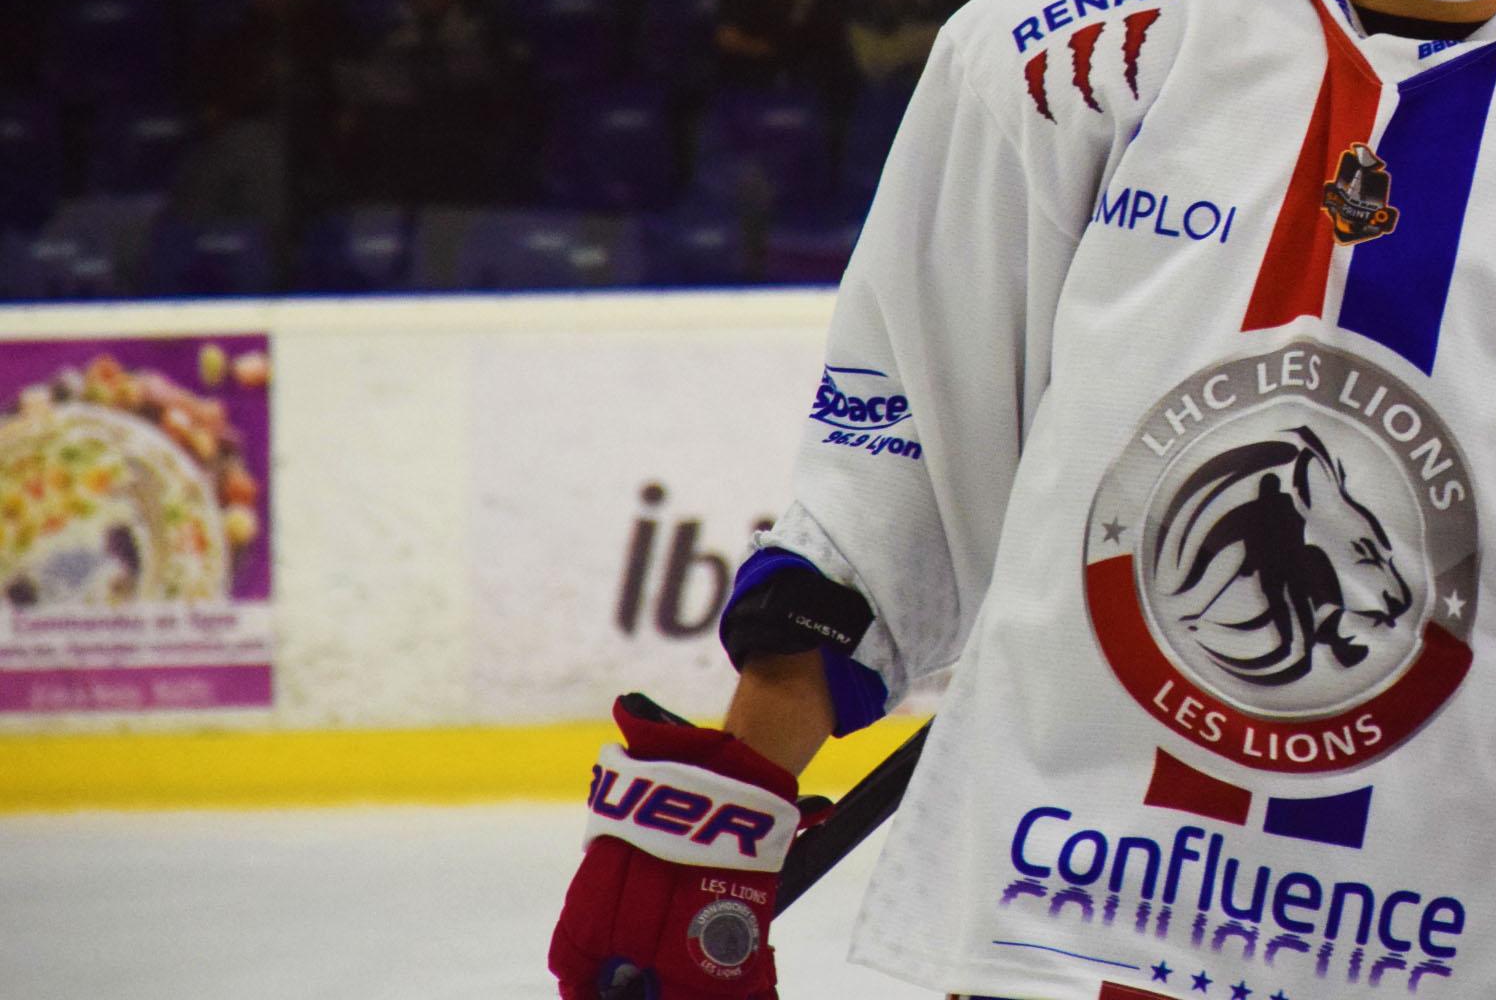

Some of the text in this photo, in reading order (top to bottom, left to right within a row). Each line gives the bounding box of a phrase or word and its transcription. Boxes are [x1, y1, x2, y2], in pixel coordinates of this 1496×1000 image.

[1090, 187, 1237, 243] MPLOI
[812, 384, 909, 424] Space
[1141, 350, 1465, 512] LHC LES LIONS
[865, 435, 923, 460] Lyon
[1152, 679, 1384, 764] LES LIONS
[701, 877, 768, 905] LES LIONS
[1010, 805, 1466, 959] Confluence
